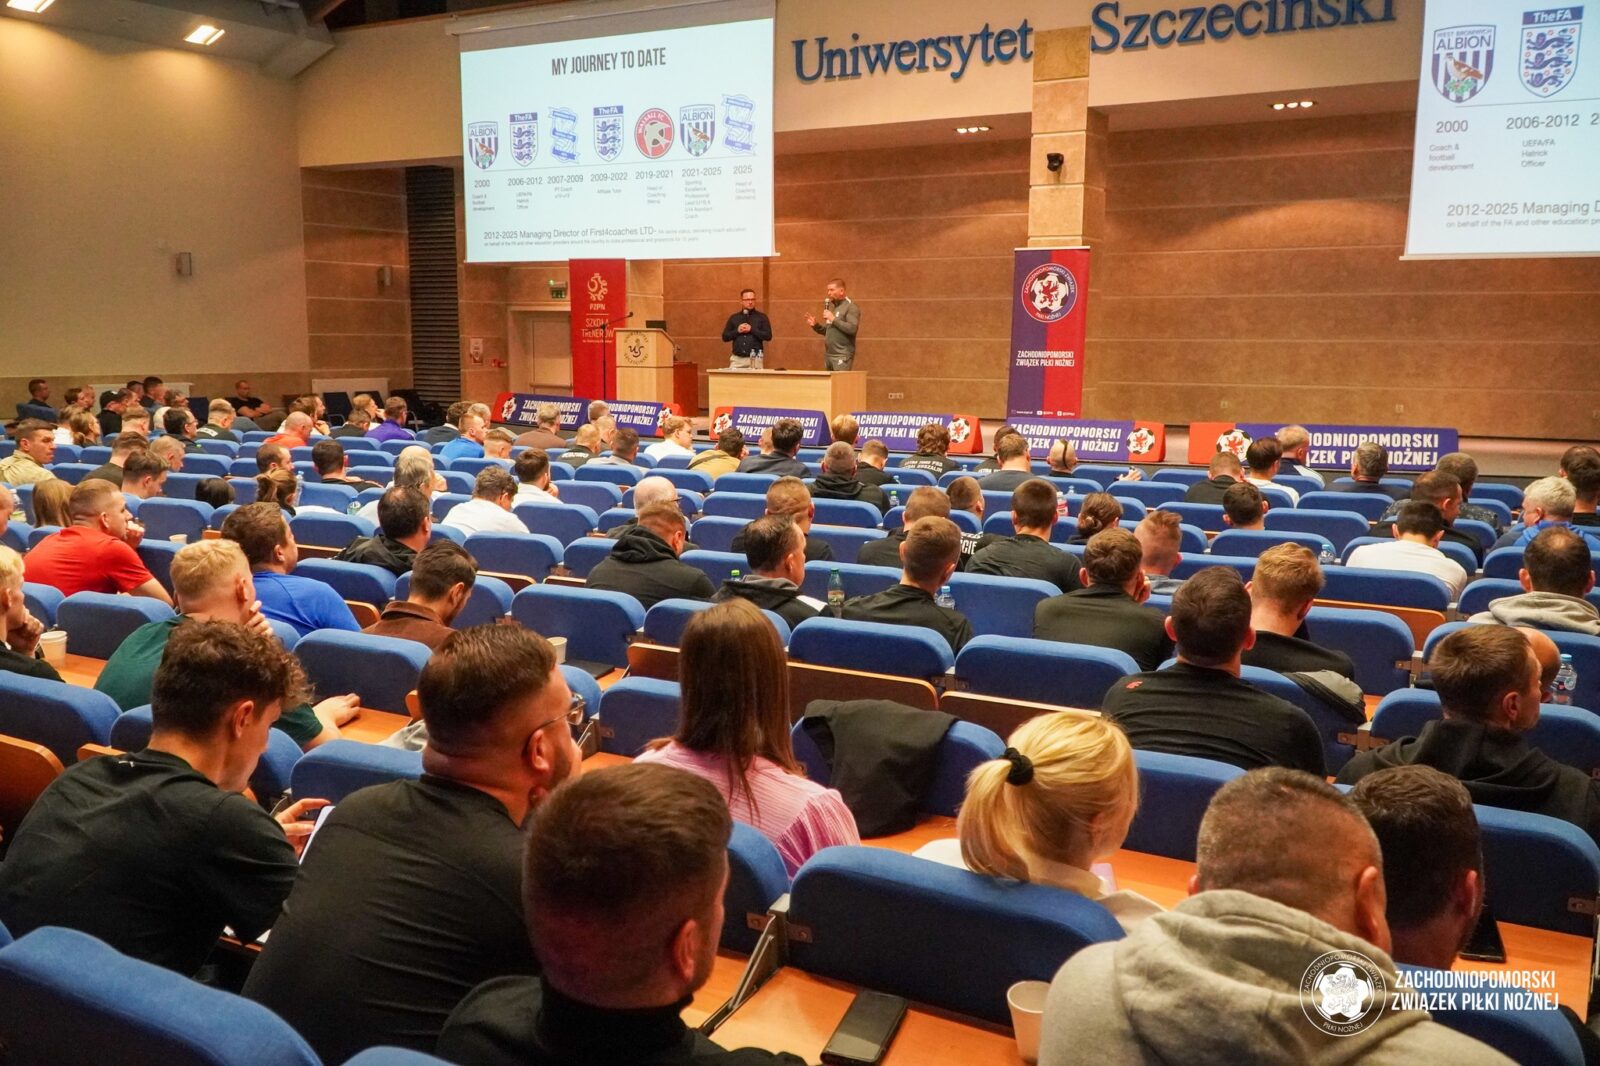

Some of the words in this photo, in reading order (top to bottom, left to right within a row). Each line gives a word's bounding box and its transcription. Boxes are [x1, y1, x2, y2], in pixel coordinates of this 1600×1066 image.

[1436, 35, 1491, 50] ALBION
[792, 19, 1033, 81] Uniwersytet
[551, 57, 568, 76] MY
[570, 52, 618, 74] JOURNEY
[620, 50, 634, 69] TO
[637, 47, 666, 67] DATE
[682, 111, 713, 121] ALBION
[1436, 120, 1469, 133] 2000
[1506, 113, 1580, 129] 2006-2012
[635, 169, 673, 179] 2019-2021
[682, 166, 722, 177] 2021-2025
[733, 164, 752, 175] 2025
[508, 176, 543, 186] 2006-2012
[547, 174, 583, 184] 2007-2009
[590, 172, 627, 182] 2009-2022
[474, 179, 490, 187] 2000
[1447, 202, 1518, 216] 2012-2025
[1522, 200, 1590, 216] Managing
[483, 230, 518, 240] 2012-2025
[520, 229, 552, 240] Managing
[553, 228, 580, 238] Director
[581, 228, 589, 237] of
[885, 427, 907, 438] PIŁKI
[1082, 438, 1119, 452] NOŻNEJ
